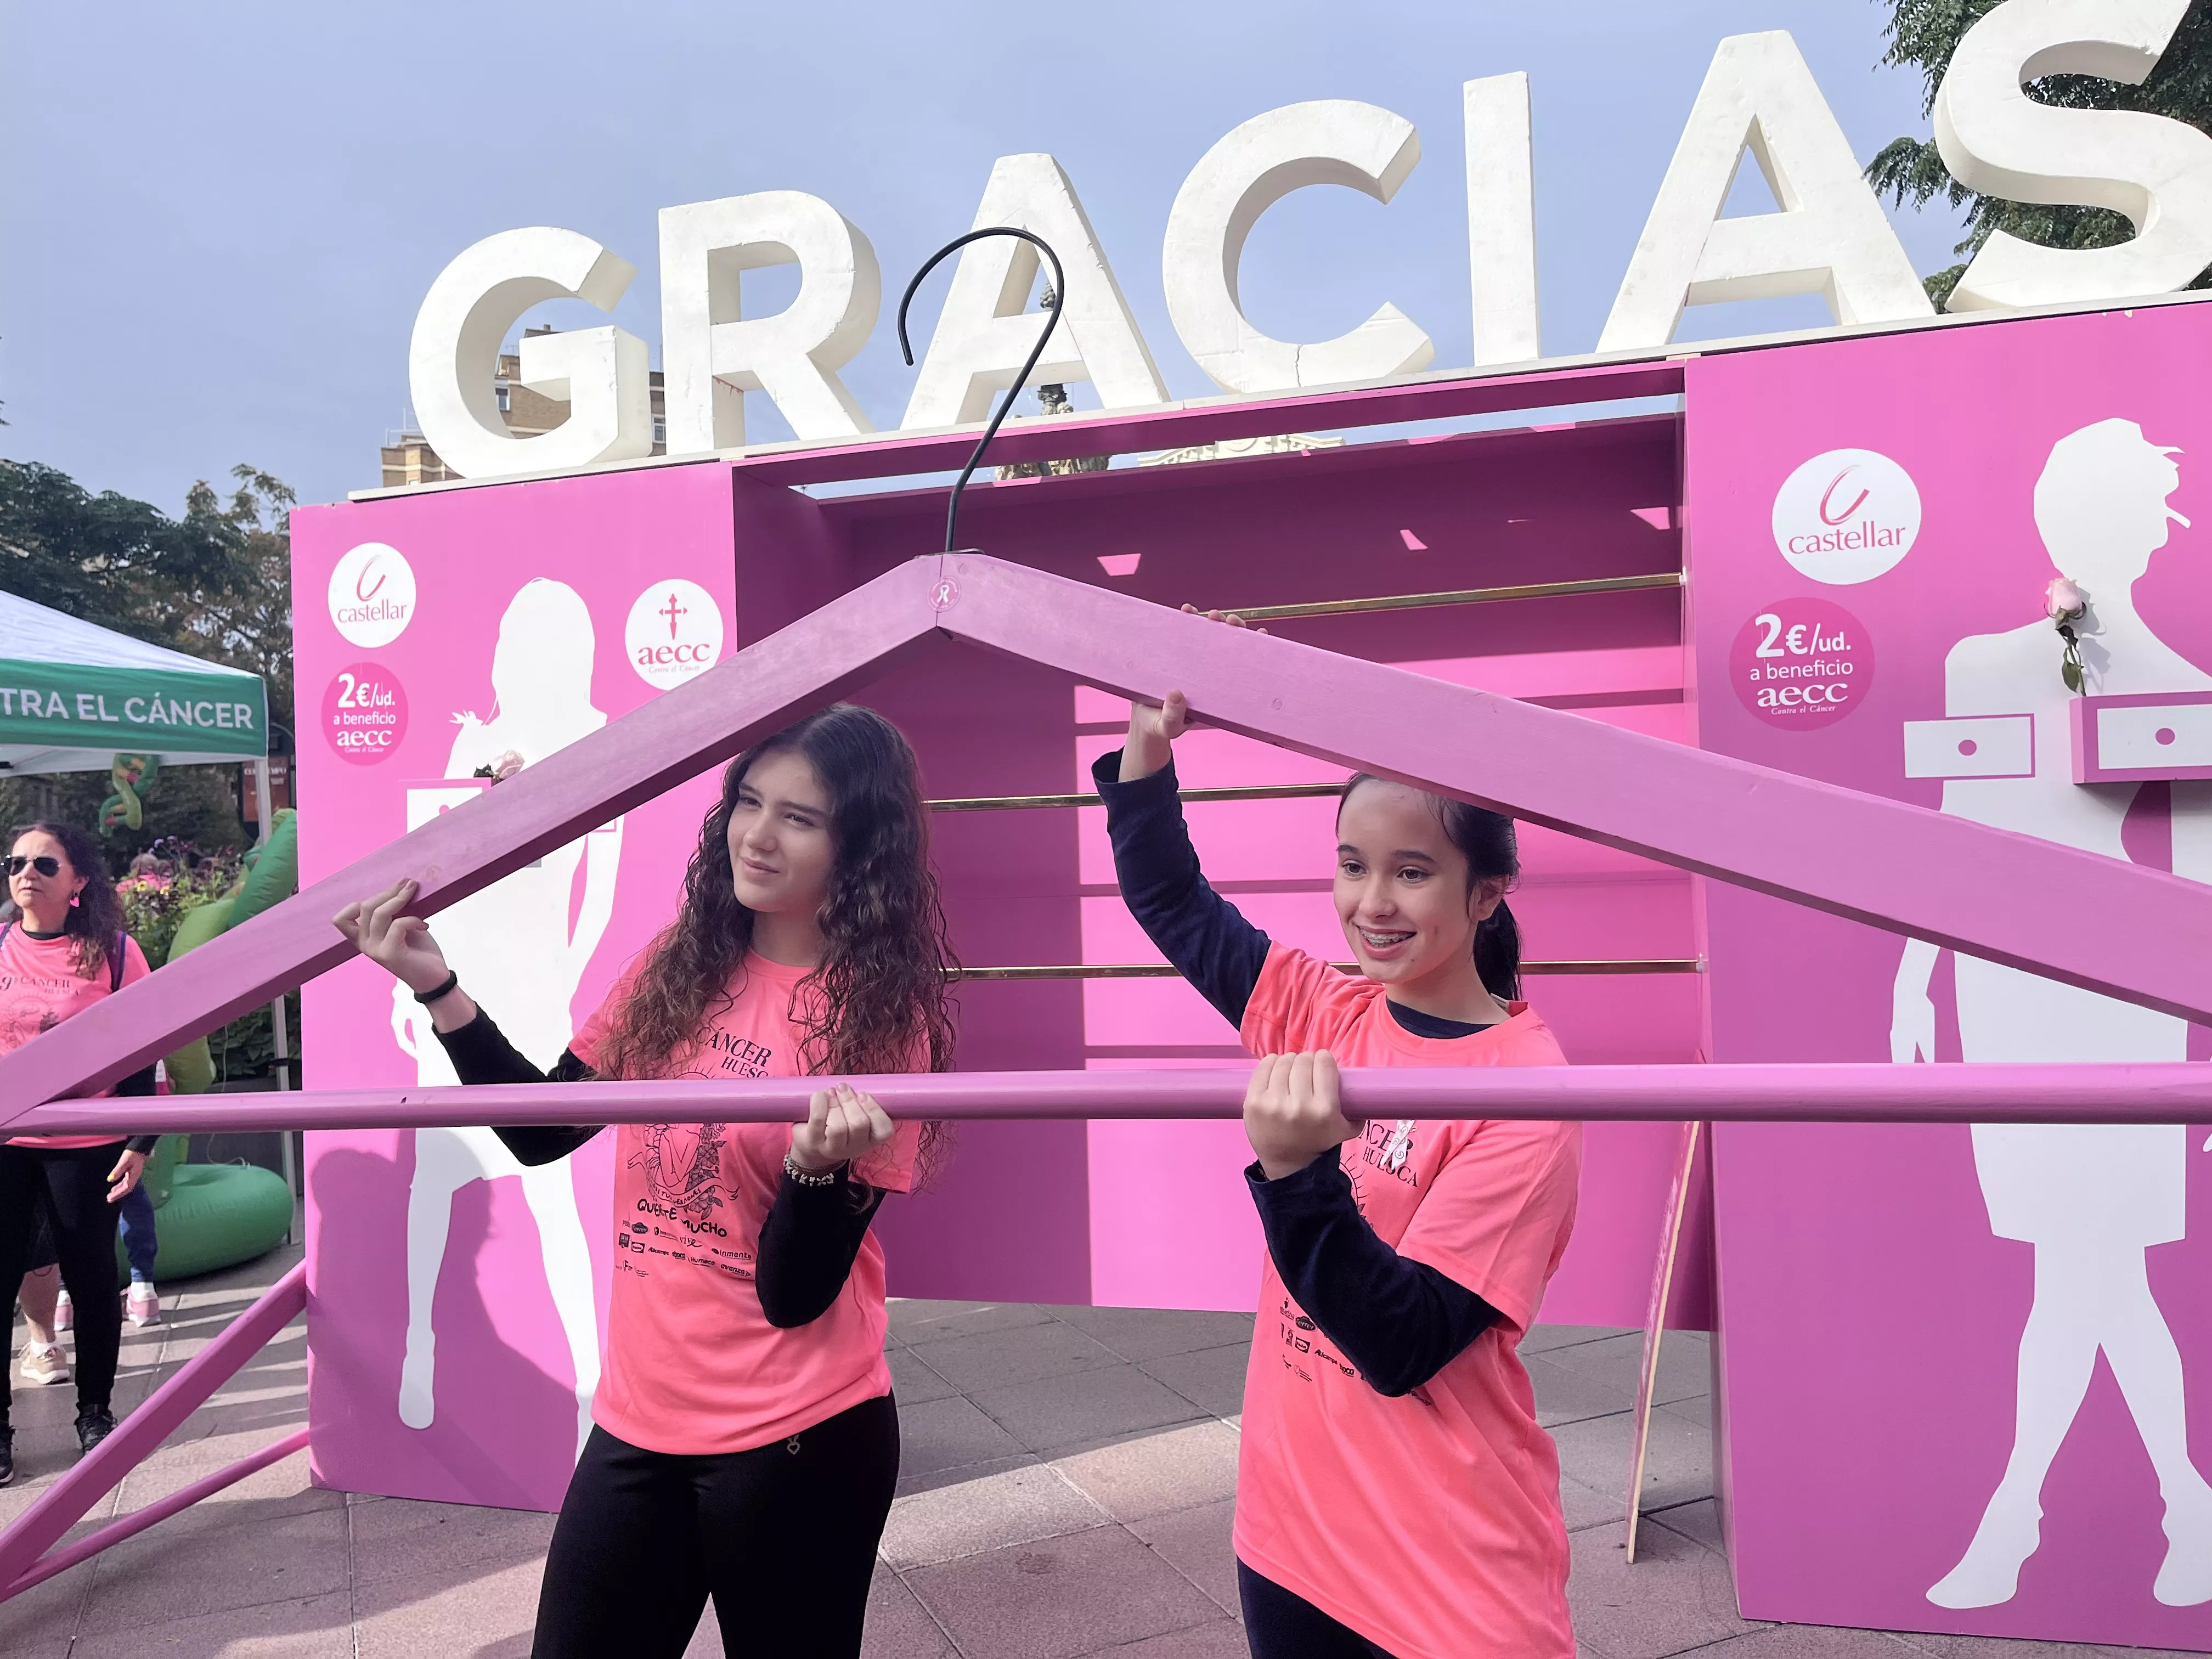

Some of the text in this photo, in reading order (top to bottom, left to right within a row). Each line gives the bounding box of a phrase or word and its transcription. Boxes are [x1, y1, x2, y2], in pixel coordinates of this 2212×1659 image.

[409, 0, 2212, 480] GRACIAS
[1788, 520, 1906, 554] castellar
[337, 599, 407, 623] castellar
[1755, 613, 1852, 658] 2€/ud.
[637, 644, 710, 665] aecc
[1750, 658, 1854, 681] a beneficio
[337, 673, 396, 708] 2€/ud.
[1757, 682, 1848, 708] aecc
[76, 693, 119, 723] EL
[124, 692, 254, 730] CÁNCER
[333, 710, 396, 725] a beneficio
[1771, 704, 1836, 715] Contra el Cáncer
[336, 730, 393, 747] aecc
